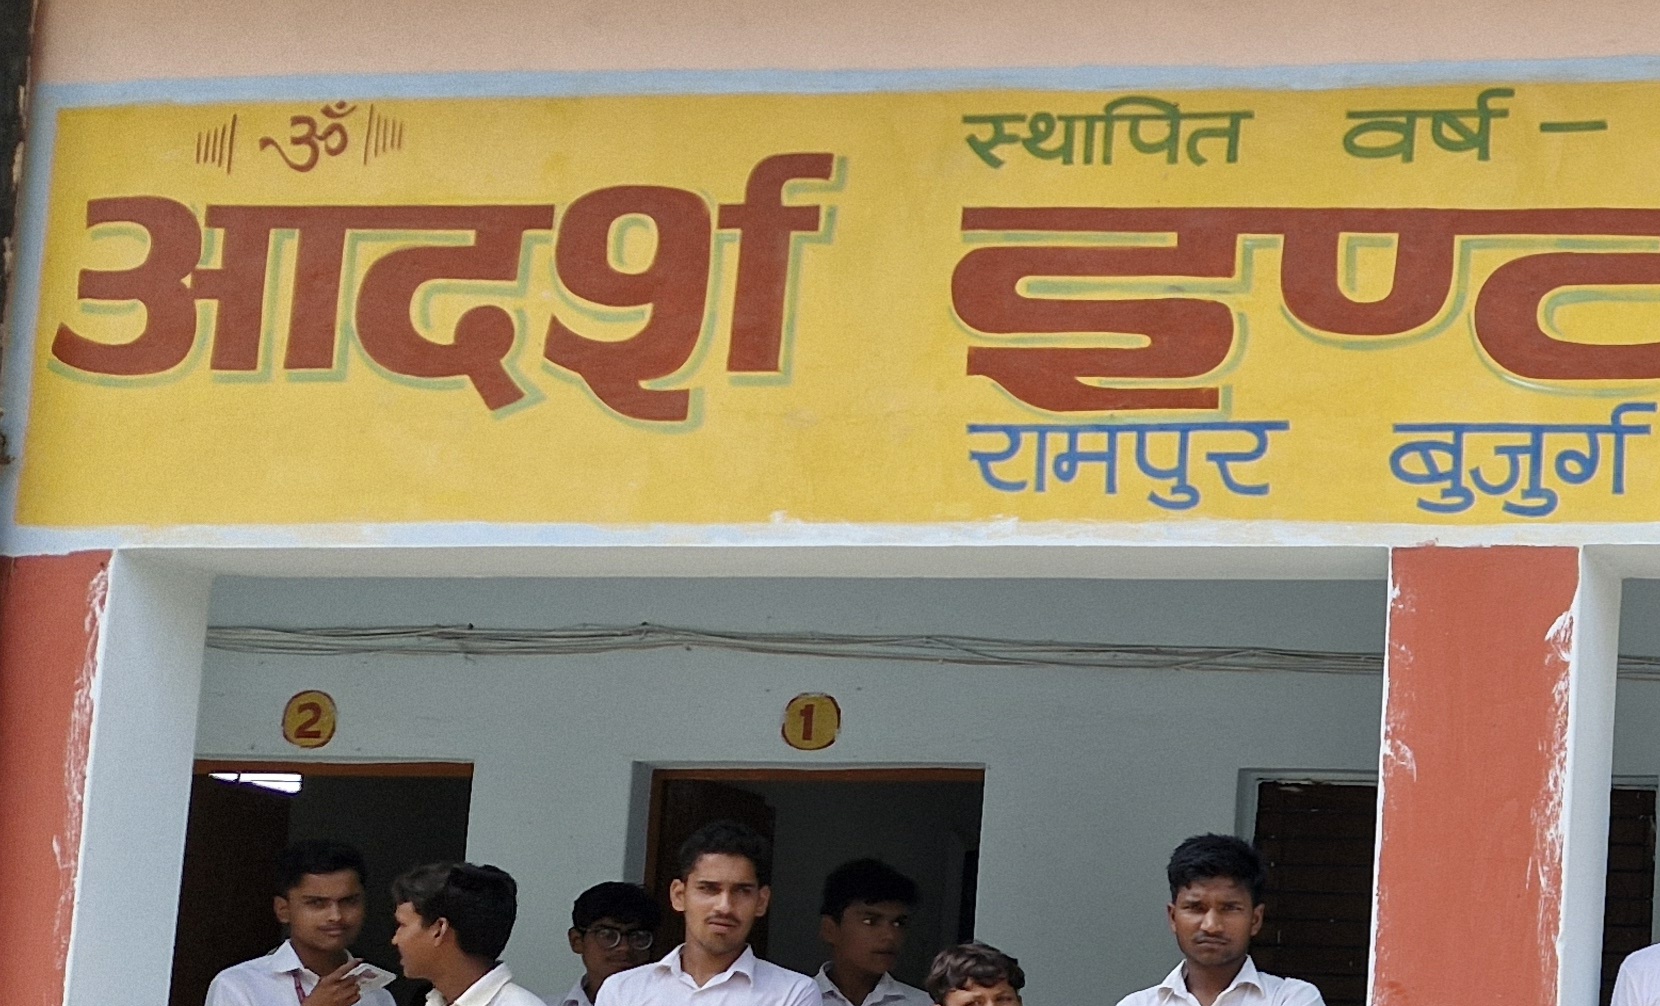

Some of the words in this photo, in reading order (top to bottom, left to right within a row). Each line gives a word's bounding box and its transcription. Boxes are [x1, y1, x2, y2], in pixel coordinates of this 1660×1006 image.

[962, 97, 1254, 169] स्थापित
[1342, 88, 1515, 163] वर्ष
[51, 152, 834, 421] आदर्श
[967, 420, 1290, 510] रामपुर
[1389, 402, 1657, 517] बुजुर्ग
[294, 702, 323, 740] 2
[799, 704, 814, 741] 1
